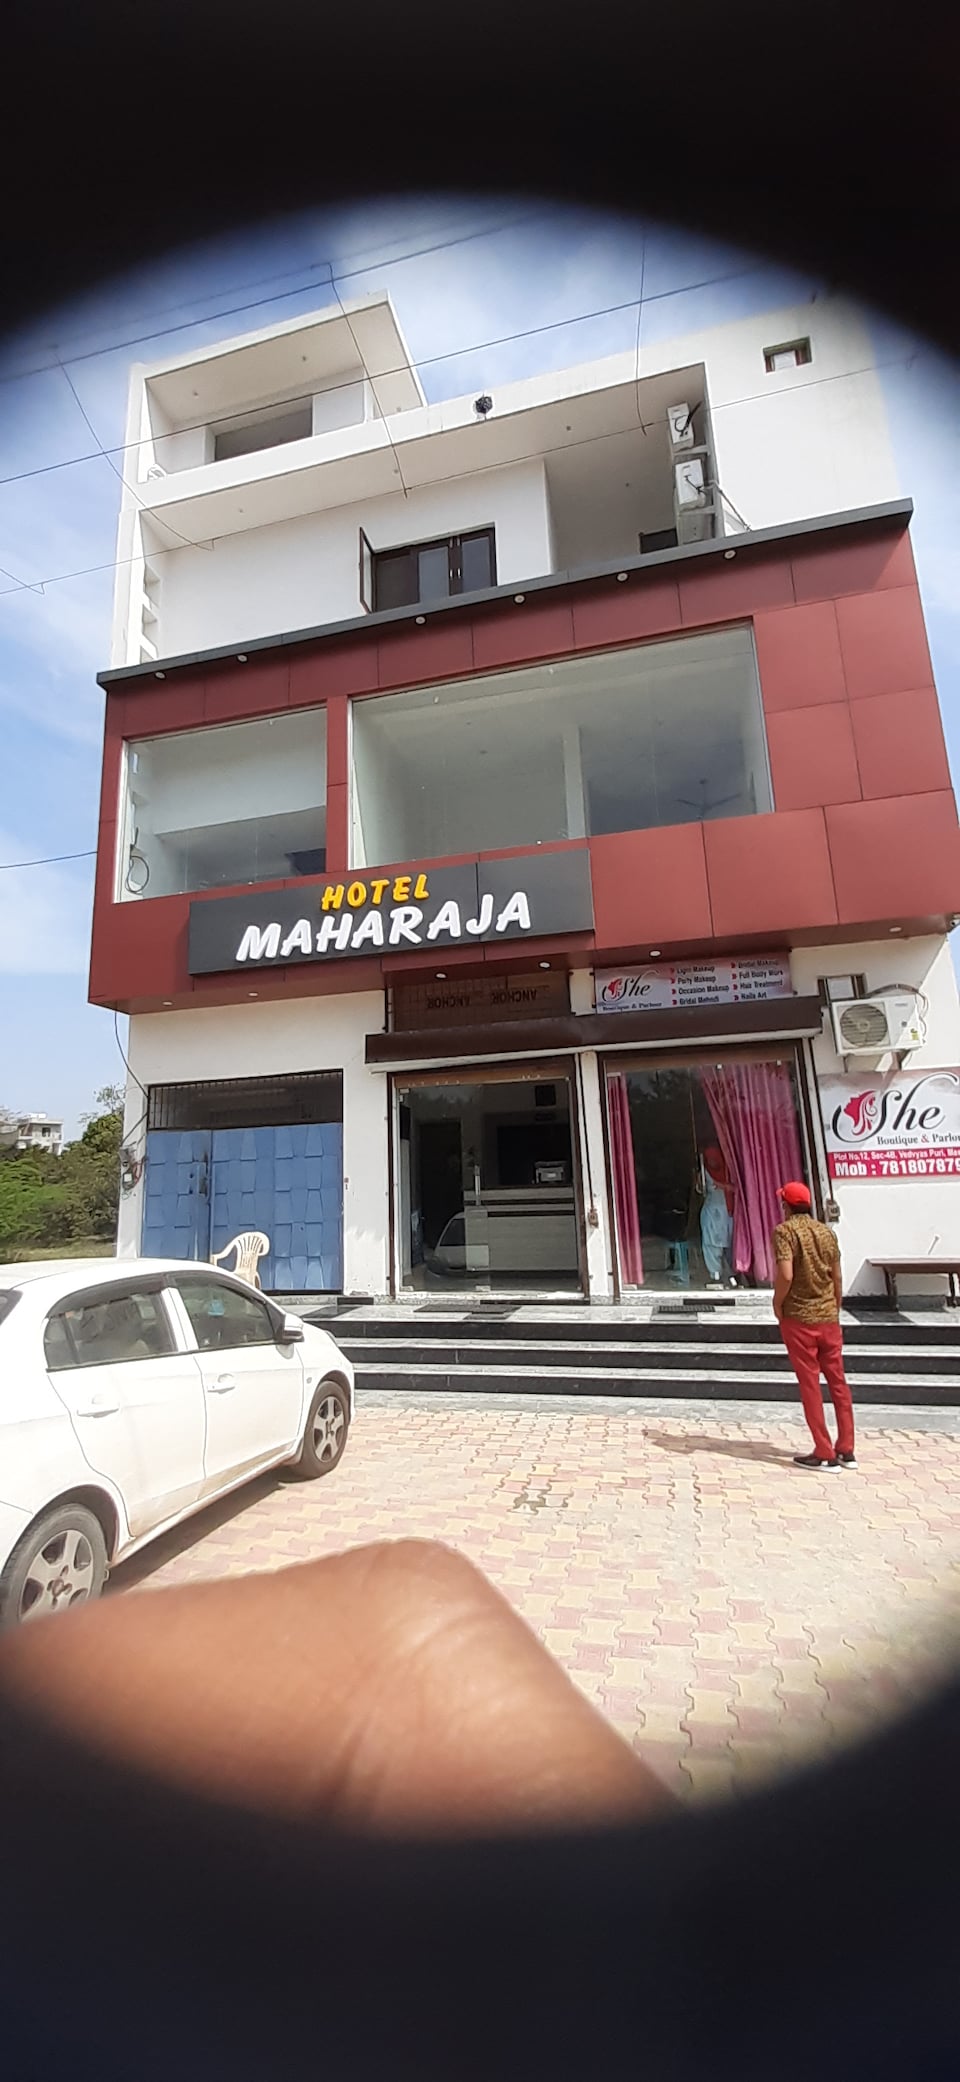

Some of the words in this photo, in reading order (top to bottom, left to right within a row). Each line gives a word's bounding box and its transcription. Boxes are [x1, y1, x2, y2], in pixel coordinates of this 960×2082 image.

[321, 873, 430, 911] HOTEL
[235, 891, 532, 962] MAHARAJA
[678, 977, 692, 985] Party
[739, 971, 750, 979] Full
[602, 970, 660, 1003] She
[678, 986, 705, 994] Occasion
[707, 985, 729, 993] Makeup
[491, 989, 537, 1005] ANCHOR
[680, 997, 696, 1005] Bridal
[832, 1071, 958, 1144] She
[877, 1135, 919, 1146] Boutique
[920, 1133, 930, 1143] &
[834, 1151, 848, 1161] Plot
[835, 1162, 867, 1176] Mob
[879, 1157, 960, 1175] 781807879
